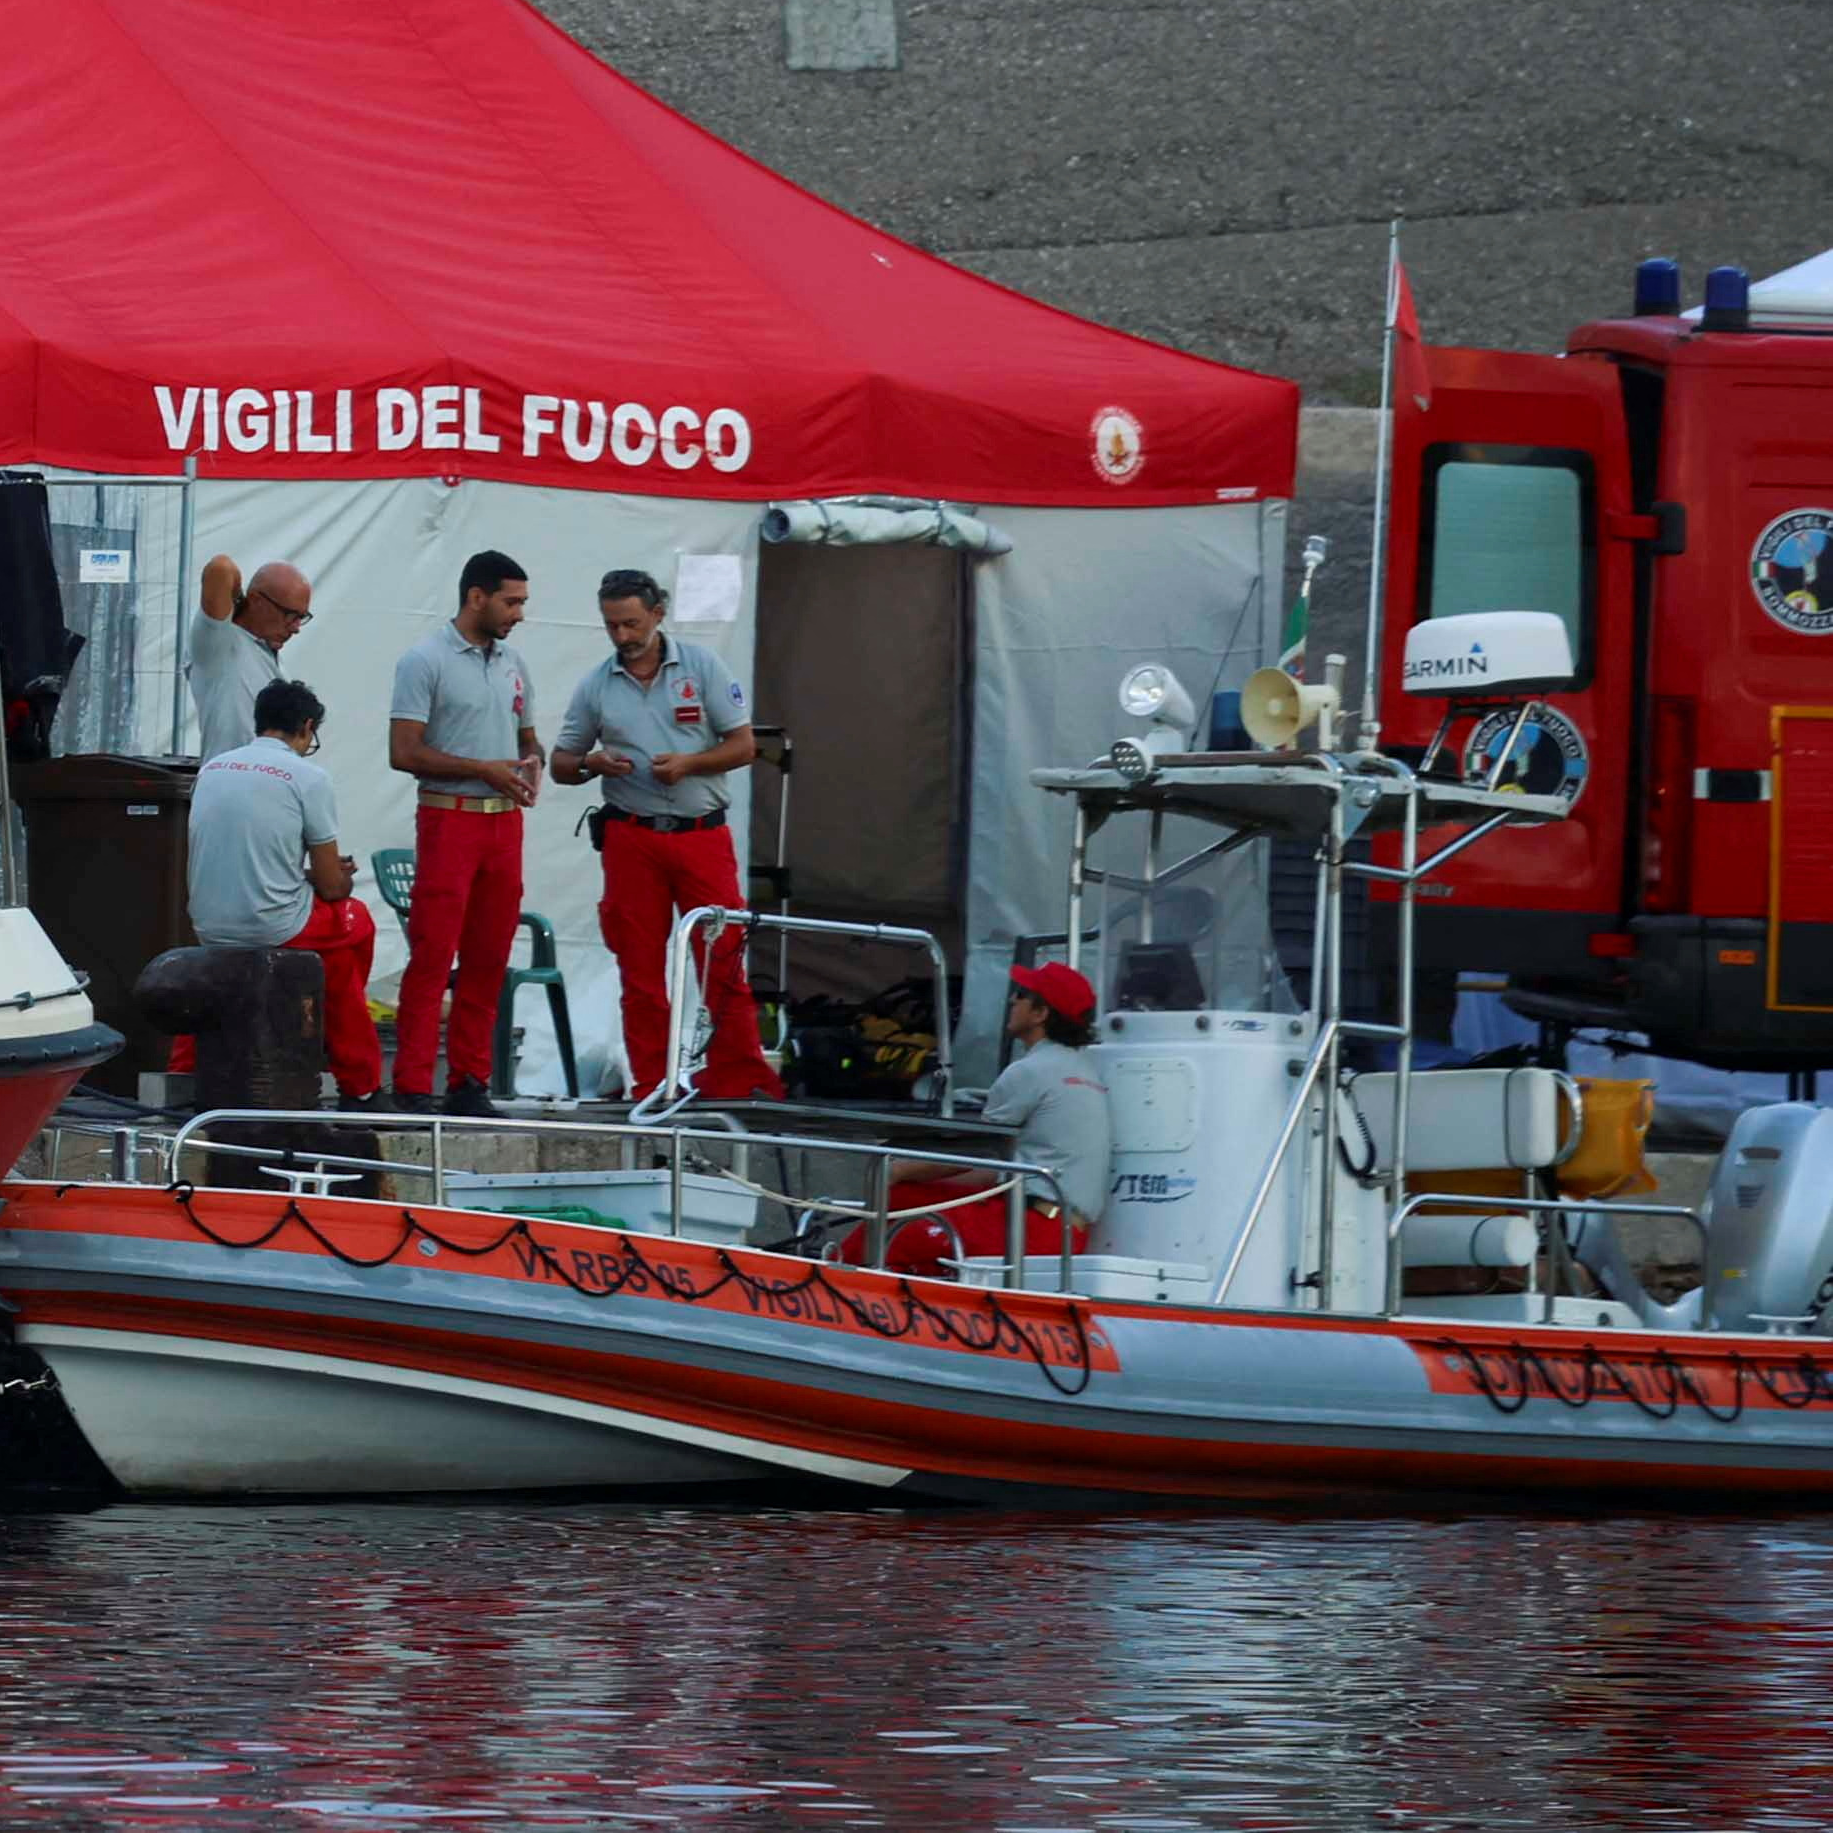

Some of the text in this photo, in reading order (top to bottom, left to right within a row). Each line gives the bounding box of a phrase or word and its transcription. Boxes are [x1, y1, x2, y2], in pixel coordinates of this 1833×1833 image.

[154, 385, 752, 473] VIGILI DEL FUOCO
[254, 764, 293, 782] FUOCO
[512, 1241, 556, 1279] VF
[737, 1271, 841, 1325] VIGILI
